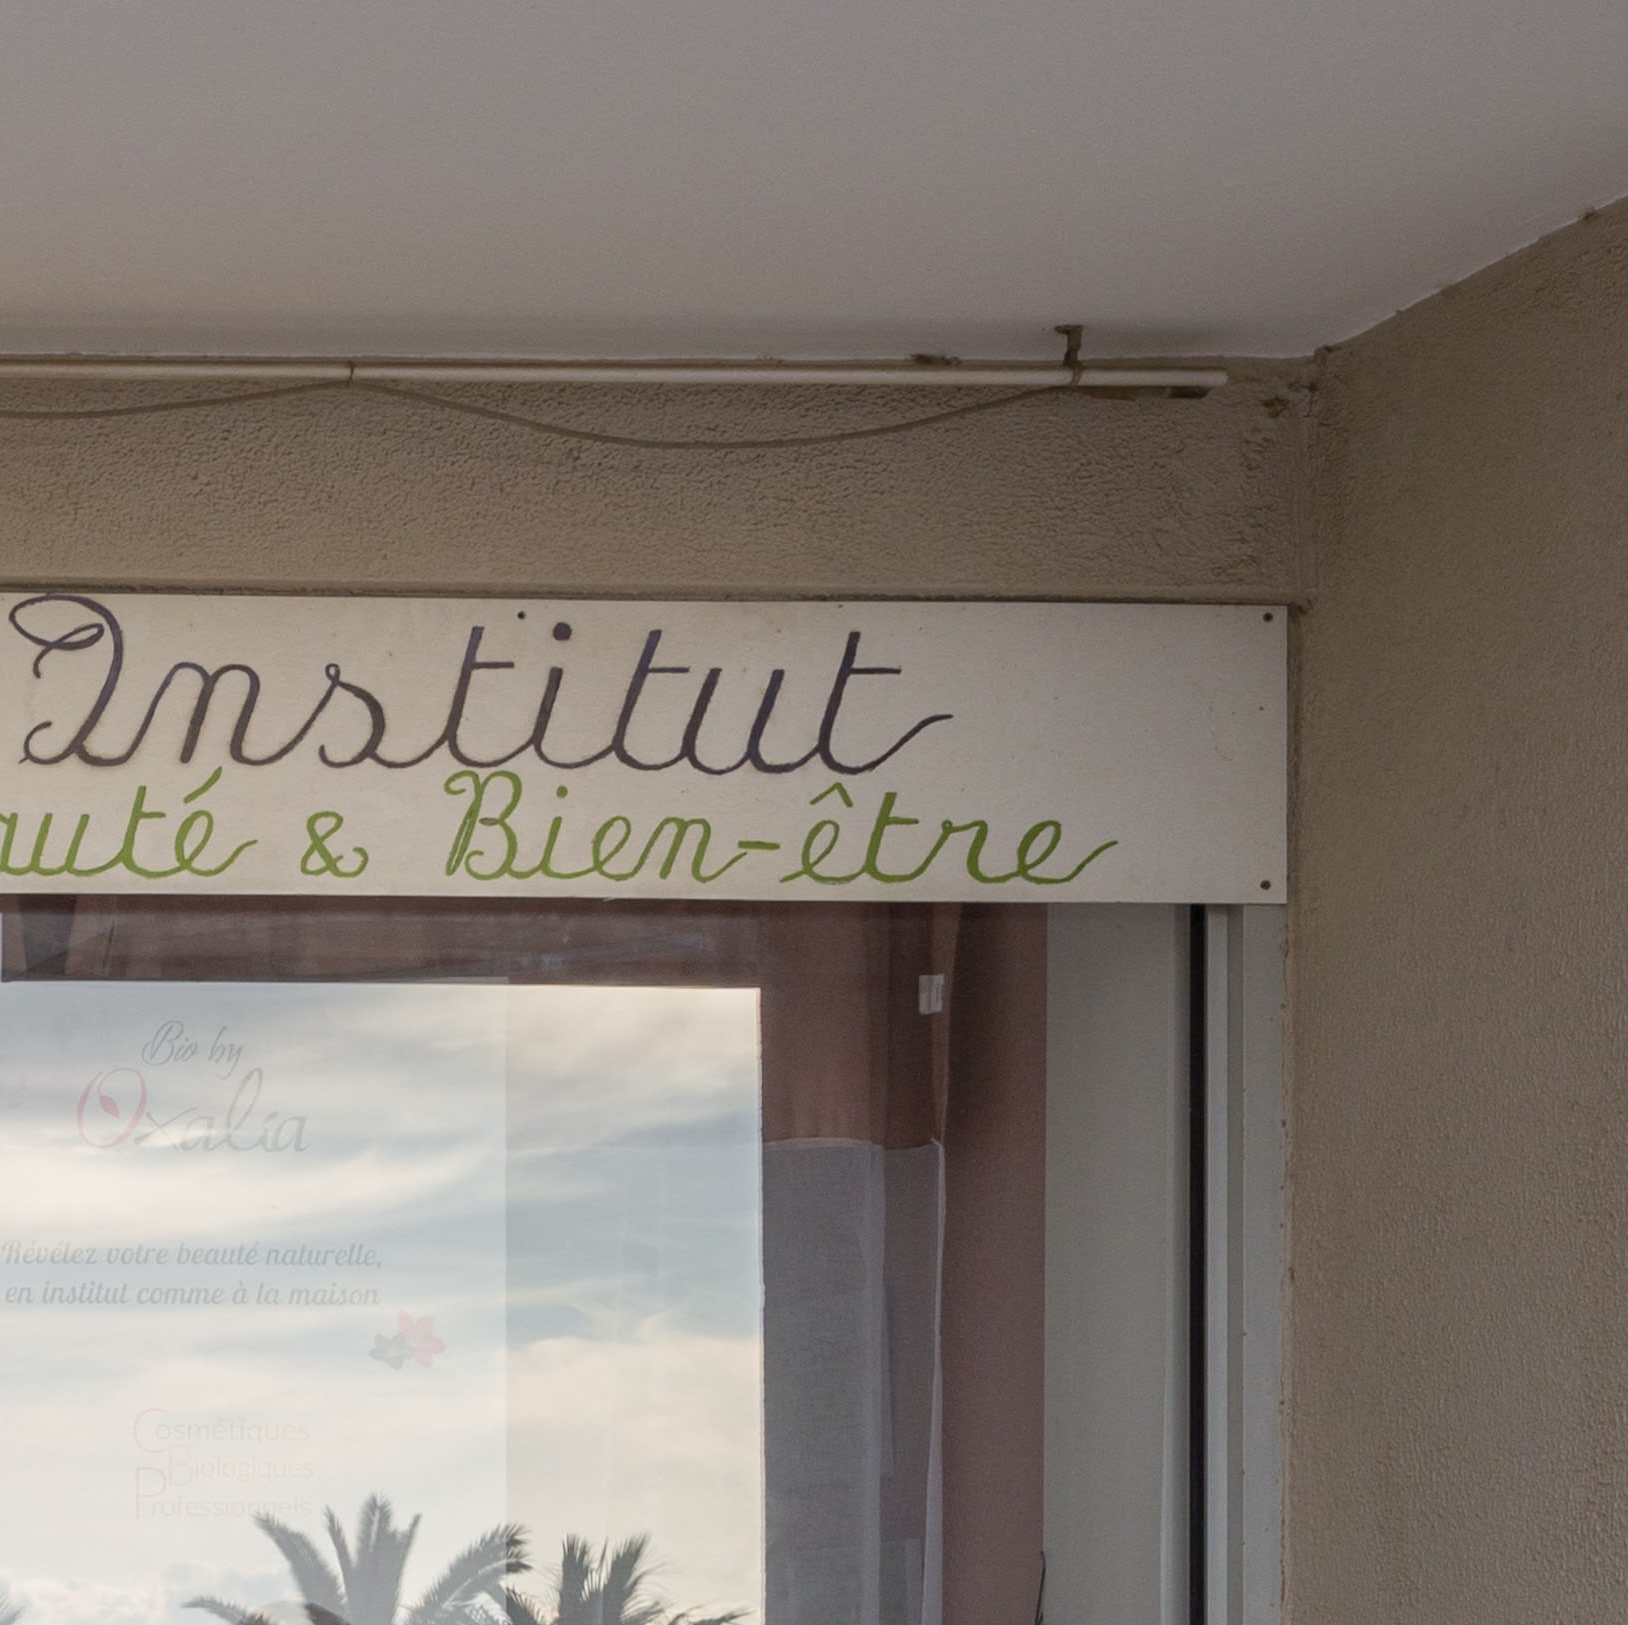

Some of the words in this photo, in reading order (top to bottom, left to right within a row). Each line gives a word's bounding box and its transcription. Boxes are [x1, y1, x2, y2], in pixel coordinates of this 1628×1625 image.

[9, 594, 953, 774] Institut
[300, 810, 369, 878] &
[444, 769, 1119, 885] Bien-être
[141, 1019, 200, 1066] Bio
[207, 1025, 246, 1080] by
[76, 1066, 311, 1153] Oxalia
[2, 1239, 98, 1266] Révélez
[106, 1243, 169, 1266] votre
[176, 1240, 260, 1267] beauté
[265, 1241, 383, 1270] naturelle,
[5, 1286, 34, 1305] en
[42, 1280, 128, 1306] institut
[136, 1285, 227, 1306] comme
[231, 1280, 250, 1306] à
[256, 1280, 280, 1306] la
[288, 1283, 382, 1307] maison
